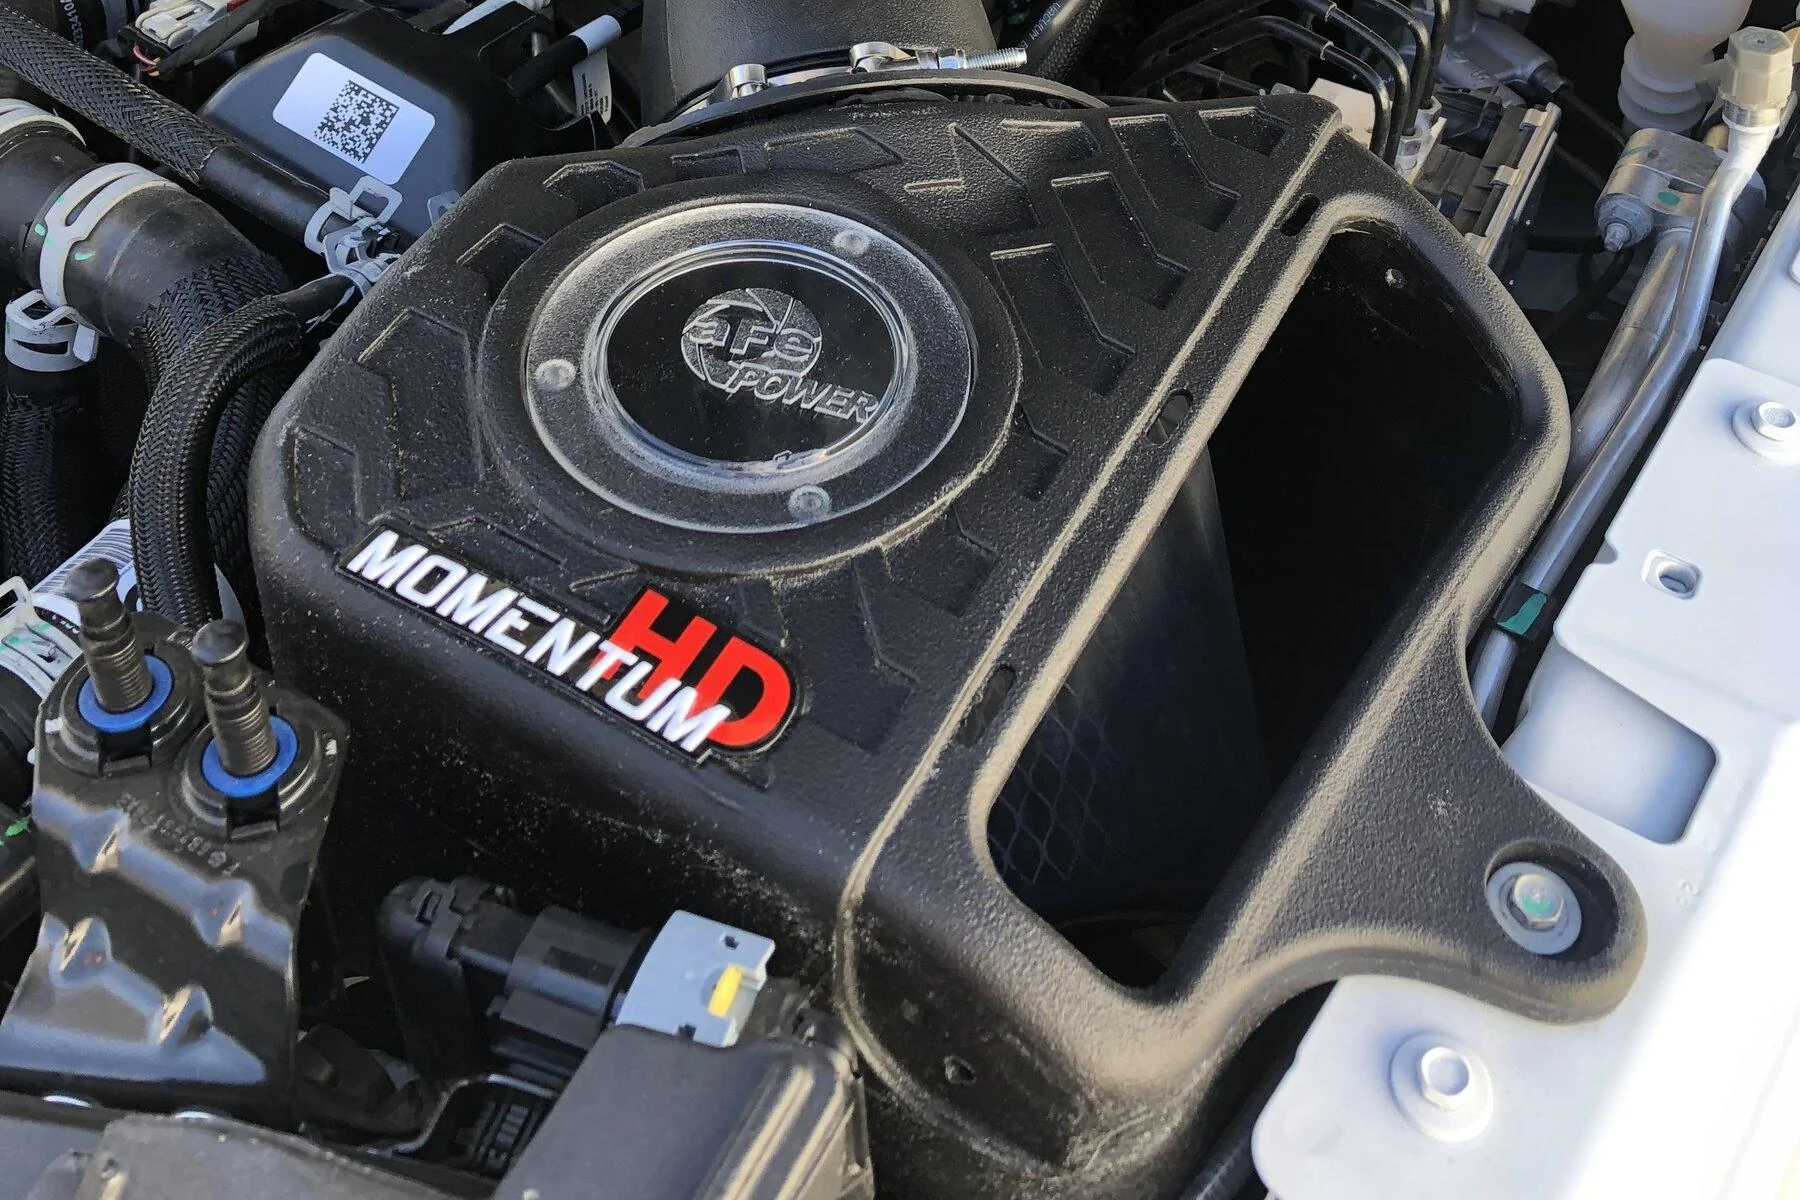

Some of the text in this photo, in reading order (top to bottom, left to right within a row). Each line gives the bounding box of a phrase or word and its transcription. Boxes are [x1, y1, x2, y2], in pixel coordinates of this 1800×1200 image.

[689, 319, 815, 362] aFe
[727, 360, 879, 425] POWER
[346, 529, 792, 753] MOMENTUM HD
